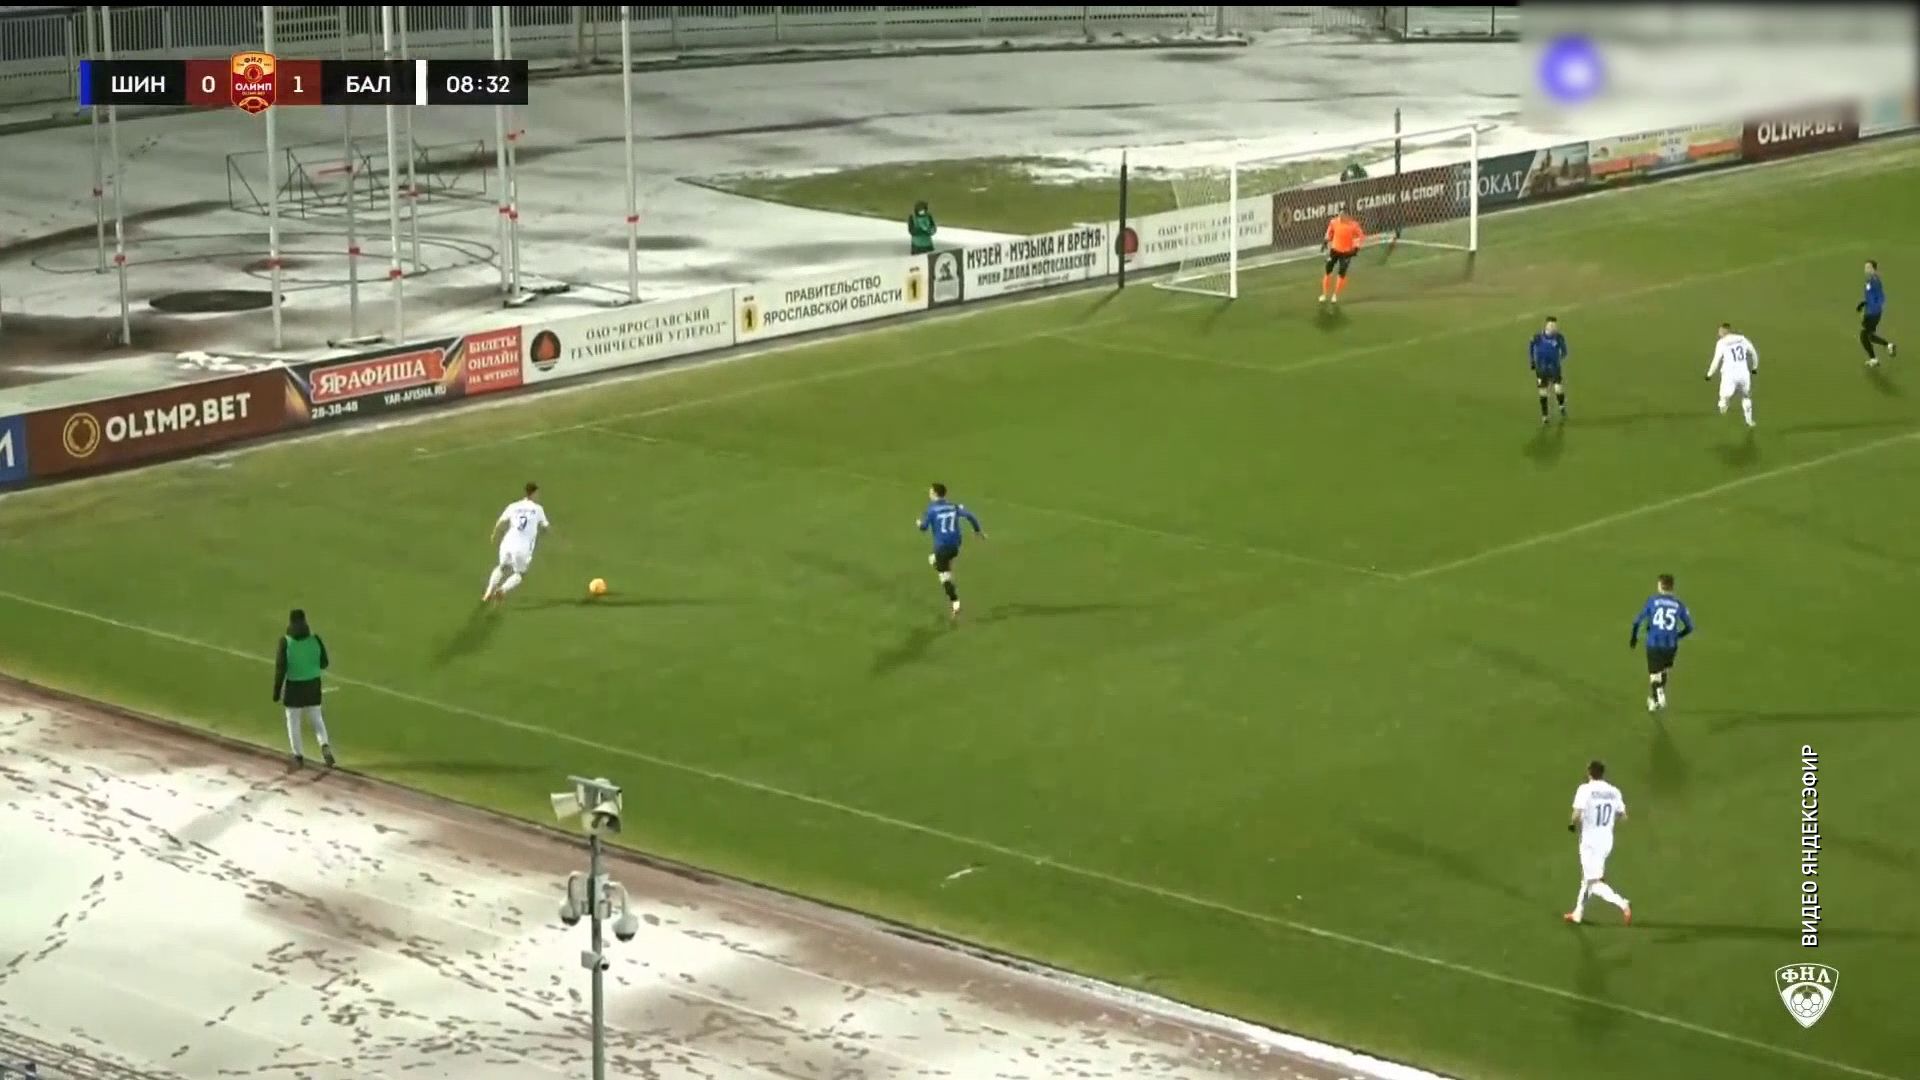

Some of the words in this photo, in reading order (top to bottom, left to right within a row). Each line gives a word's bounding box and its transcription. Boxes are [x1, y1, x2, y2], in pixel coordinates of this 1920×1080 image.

[1455, 171, 1523, 202] ПОКАТ
[967, 243, 1001, 269] МУЗЕЙ
[785, 275, 881, 303] ПРАВИТЕЛЬСТВО
[763, 298, 848, 326] ЯРОСЛАВСКОЙ
[850, 288, 902, 309] ОБЛАСТИ
[469, 336, 517, 354] БИЛЕТЫ
[1731, 345, 1745, 362] 13
[468, 350, 519, 370] ОНЛАЙН
[319, 358, 427, 396] ЯРАФИША
[105, 392, 251, 442] OLIMP.BET
[937, 511, 956, 533] 77
[1653, 607, 1676, 631] 45
[1595, 803, 1612, 827] 10
